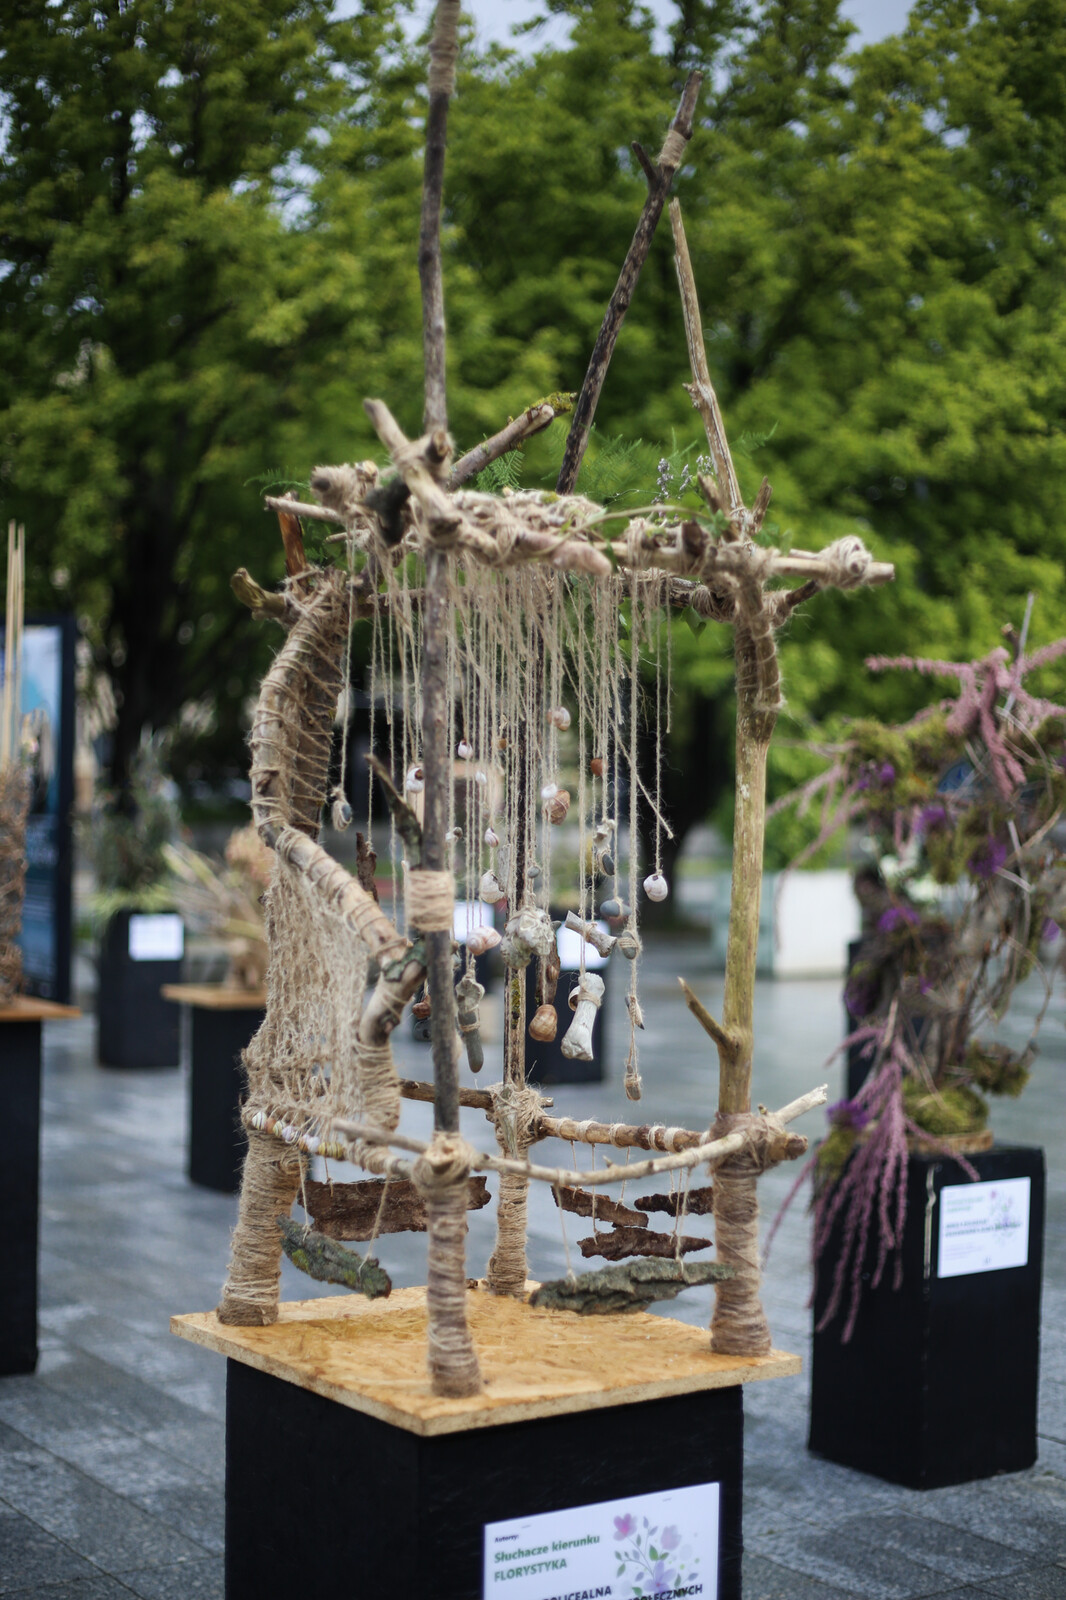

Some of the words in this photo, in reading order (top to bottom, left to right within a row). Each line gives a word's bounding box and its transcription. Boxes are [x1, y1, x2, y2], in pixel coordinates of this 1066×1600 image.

[494, 1545, 549, 1563] Słuchacze
[551, 1534, 600, 1552] kierunku
[494, 1558, 567, 1582] FLORYSTYKA
[543, 1585, 612, 1600] ICEALNA
[628, 1583, 703, 1600] OŁECZNYCH
